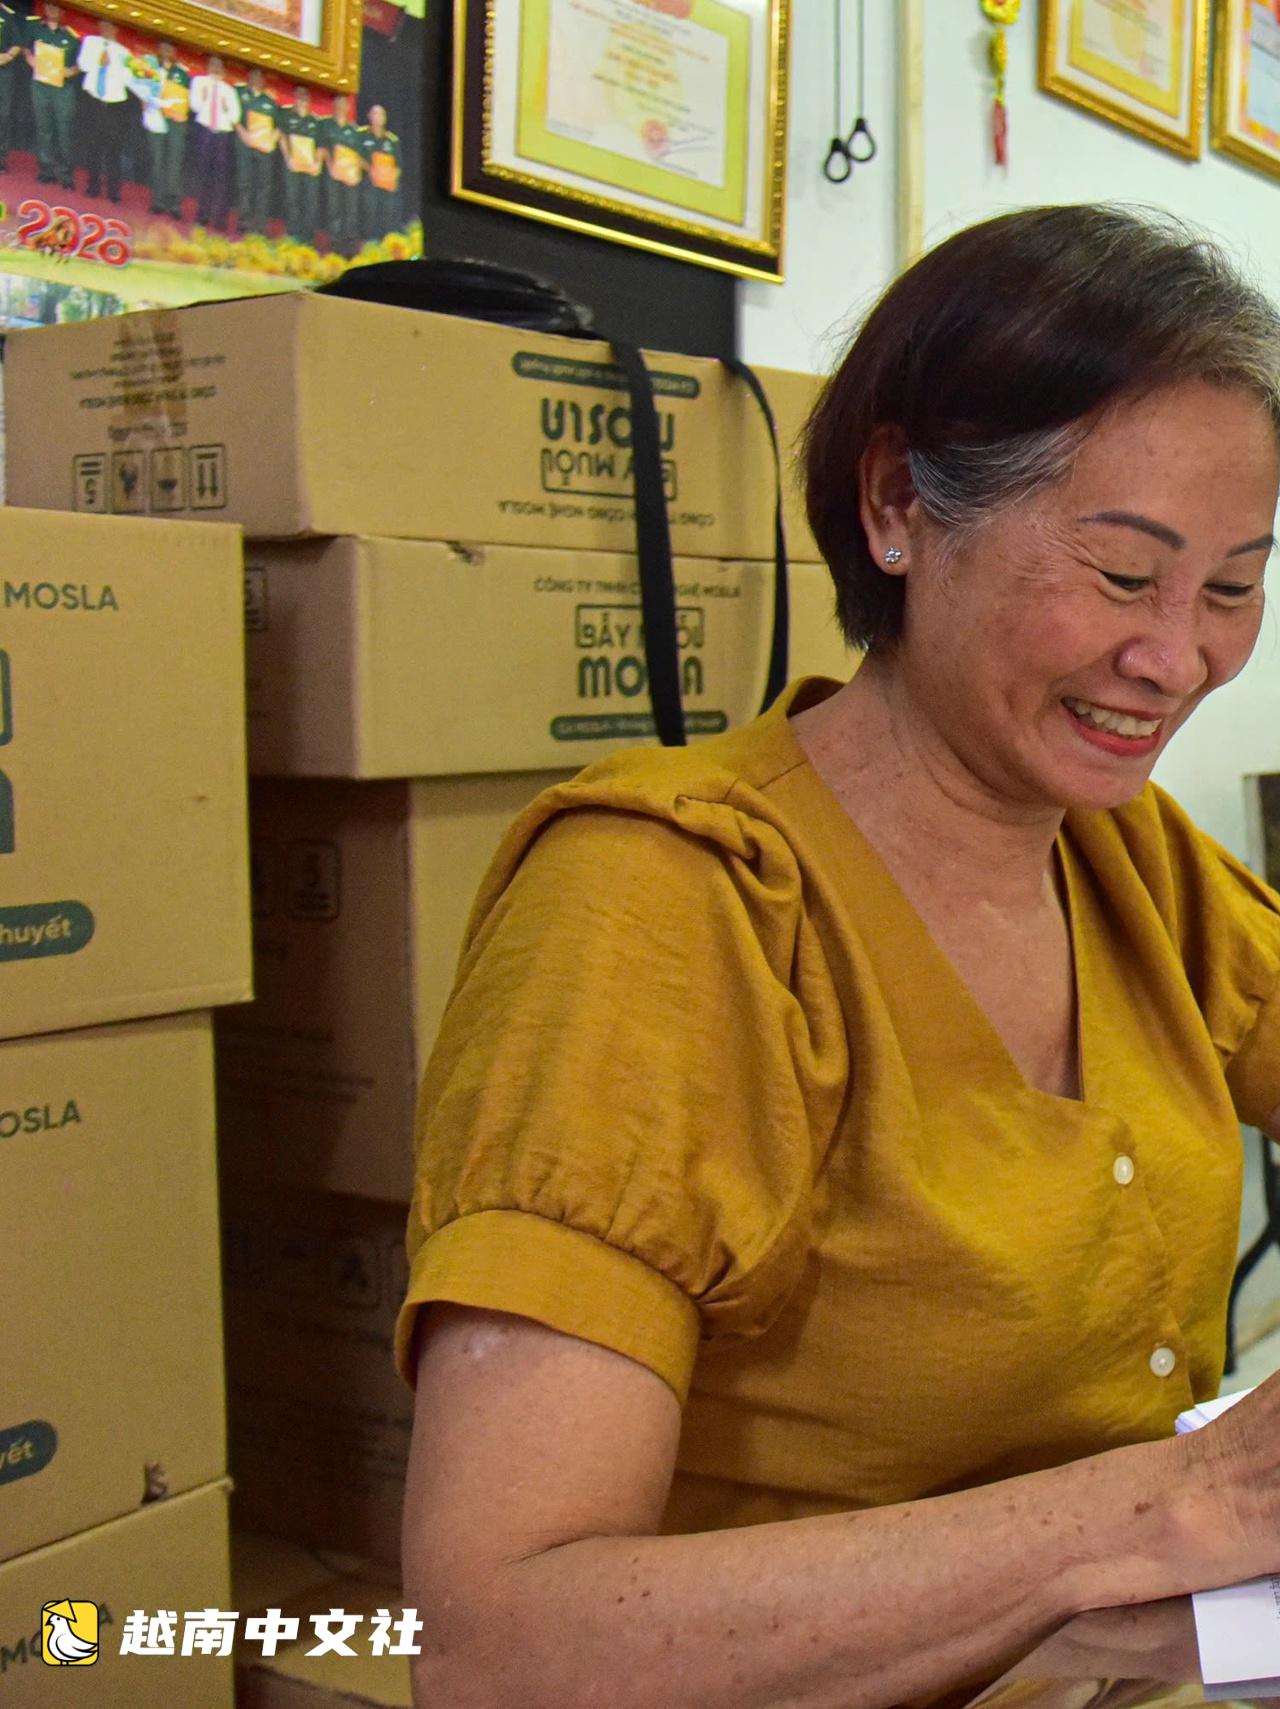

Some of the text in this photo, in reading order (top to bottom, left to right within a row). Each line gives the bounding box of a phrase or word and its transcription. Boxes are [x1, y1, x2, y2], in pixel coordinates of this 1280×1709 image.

[17, 199, 131, 267] 2026
[4, 581, 119, 611] MOSLA
[577, 655, 704, 698] MOA
